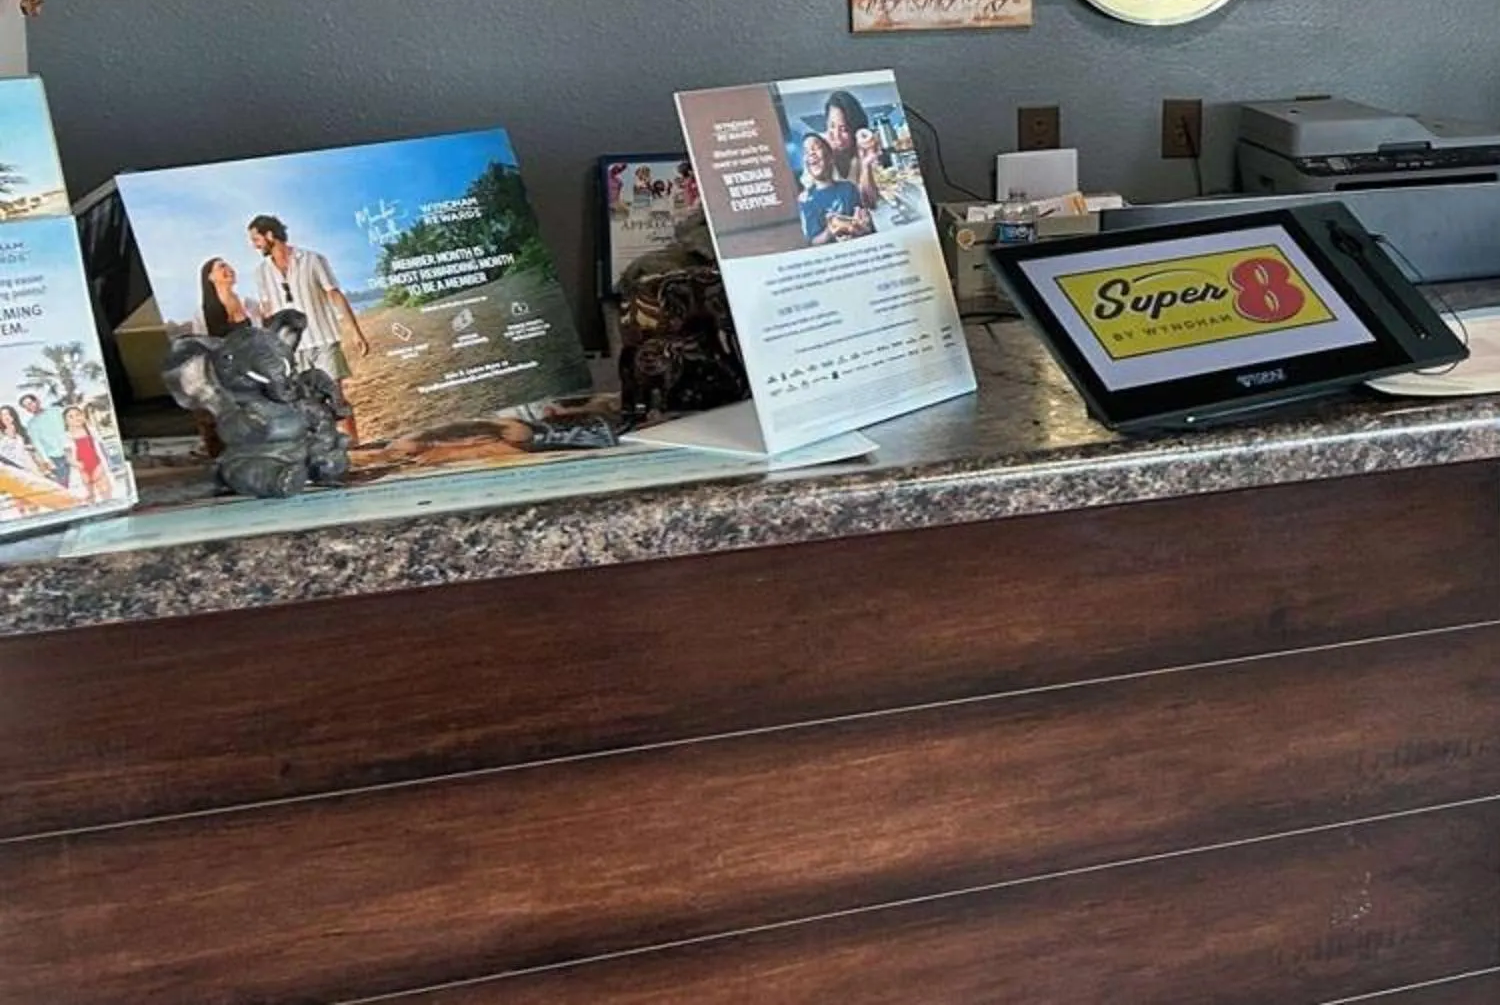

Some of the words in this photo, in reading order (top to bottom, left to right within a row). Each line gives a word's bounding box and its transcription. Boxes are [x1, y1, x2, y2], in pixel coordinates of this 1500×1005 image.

[388, 271, 420, 287] MOST
[420, 259, 479, 281] REWARDING
[479, 252, 516, 270] MONTH
[436, 247, 473, 264] MONTH
[405, 283, 422, 297] TO
[422, 281, 437, 294] BE
[445, 271, 489, 289] MEMBER
[1094, 277, 1229, 320] Super
[1228, 257, 1306, 324] 8
[1112, 330, 1134, 342] BY
[1141, 313, 1233, 336] WYNDHAM
